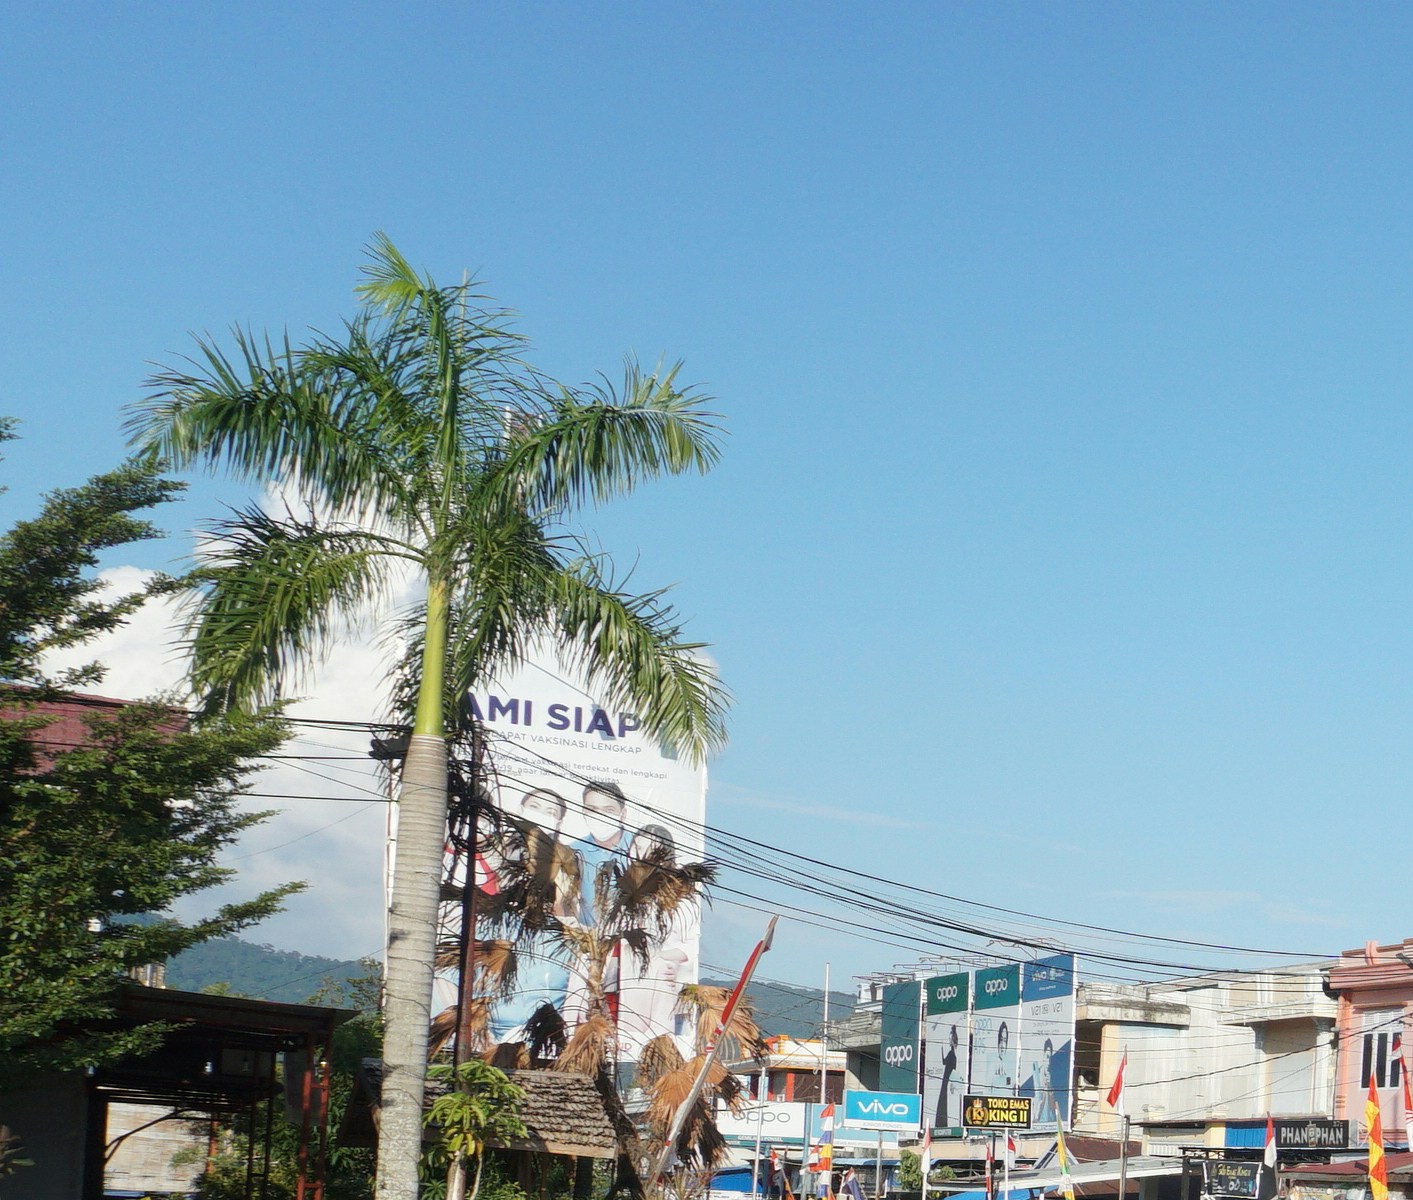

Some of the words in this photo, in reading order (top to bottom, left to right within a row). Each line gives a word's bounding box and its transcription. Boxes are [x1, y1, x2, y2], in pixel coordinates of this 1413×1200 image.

[468, 691, 533, 727] AMI
[546, 703, 642, 738] SIAP
[530, 734, 588, 749] VAKSINASI
[591, 741, 642, 754] LENGKAP
[573, 762, 611, 774] terdekat
[612, 766, 629, 776] dan
[630, 767, 668, 780] lengkapi
[936, 985, 958, 1002] oppo
[984, 978, 1008, 996] oppo
[885, 1044, 913, 1067] oppo
[857, 1099, 909, 1115] vivo
[988, 1098, 1009, 1109] TOKO
[1009, 1099, 1029, 1110] EMAS
[989, 1110, 1018, 1122] KING
[1281, 1127, 1308, 1144] PHAN
[1316, 1127, 1343, 1145] PHAN
